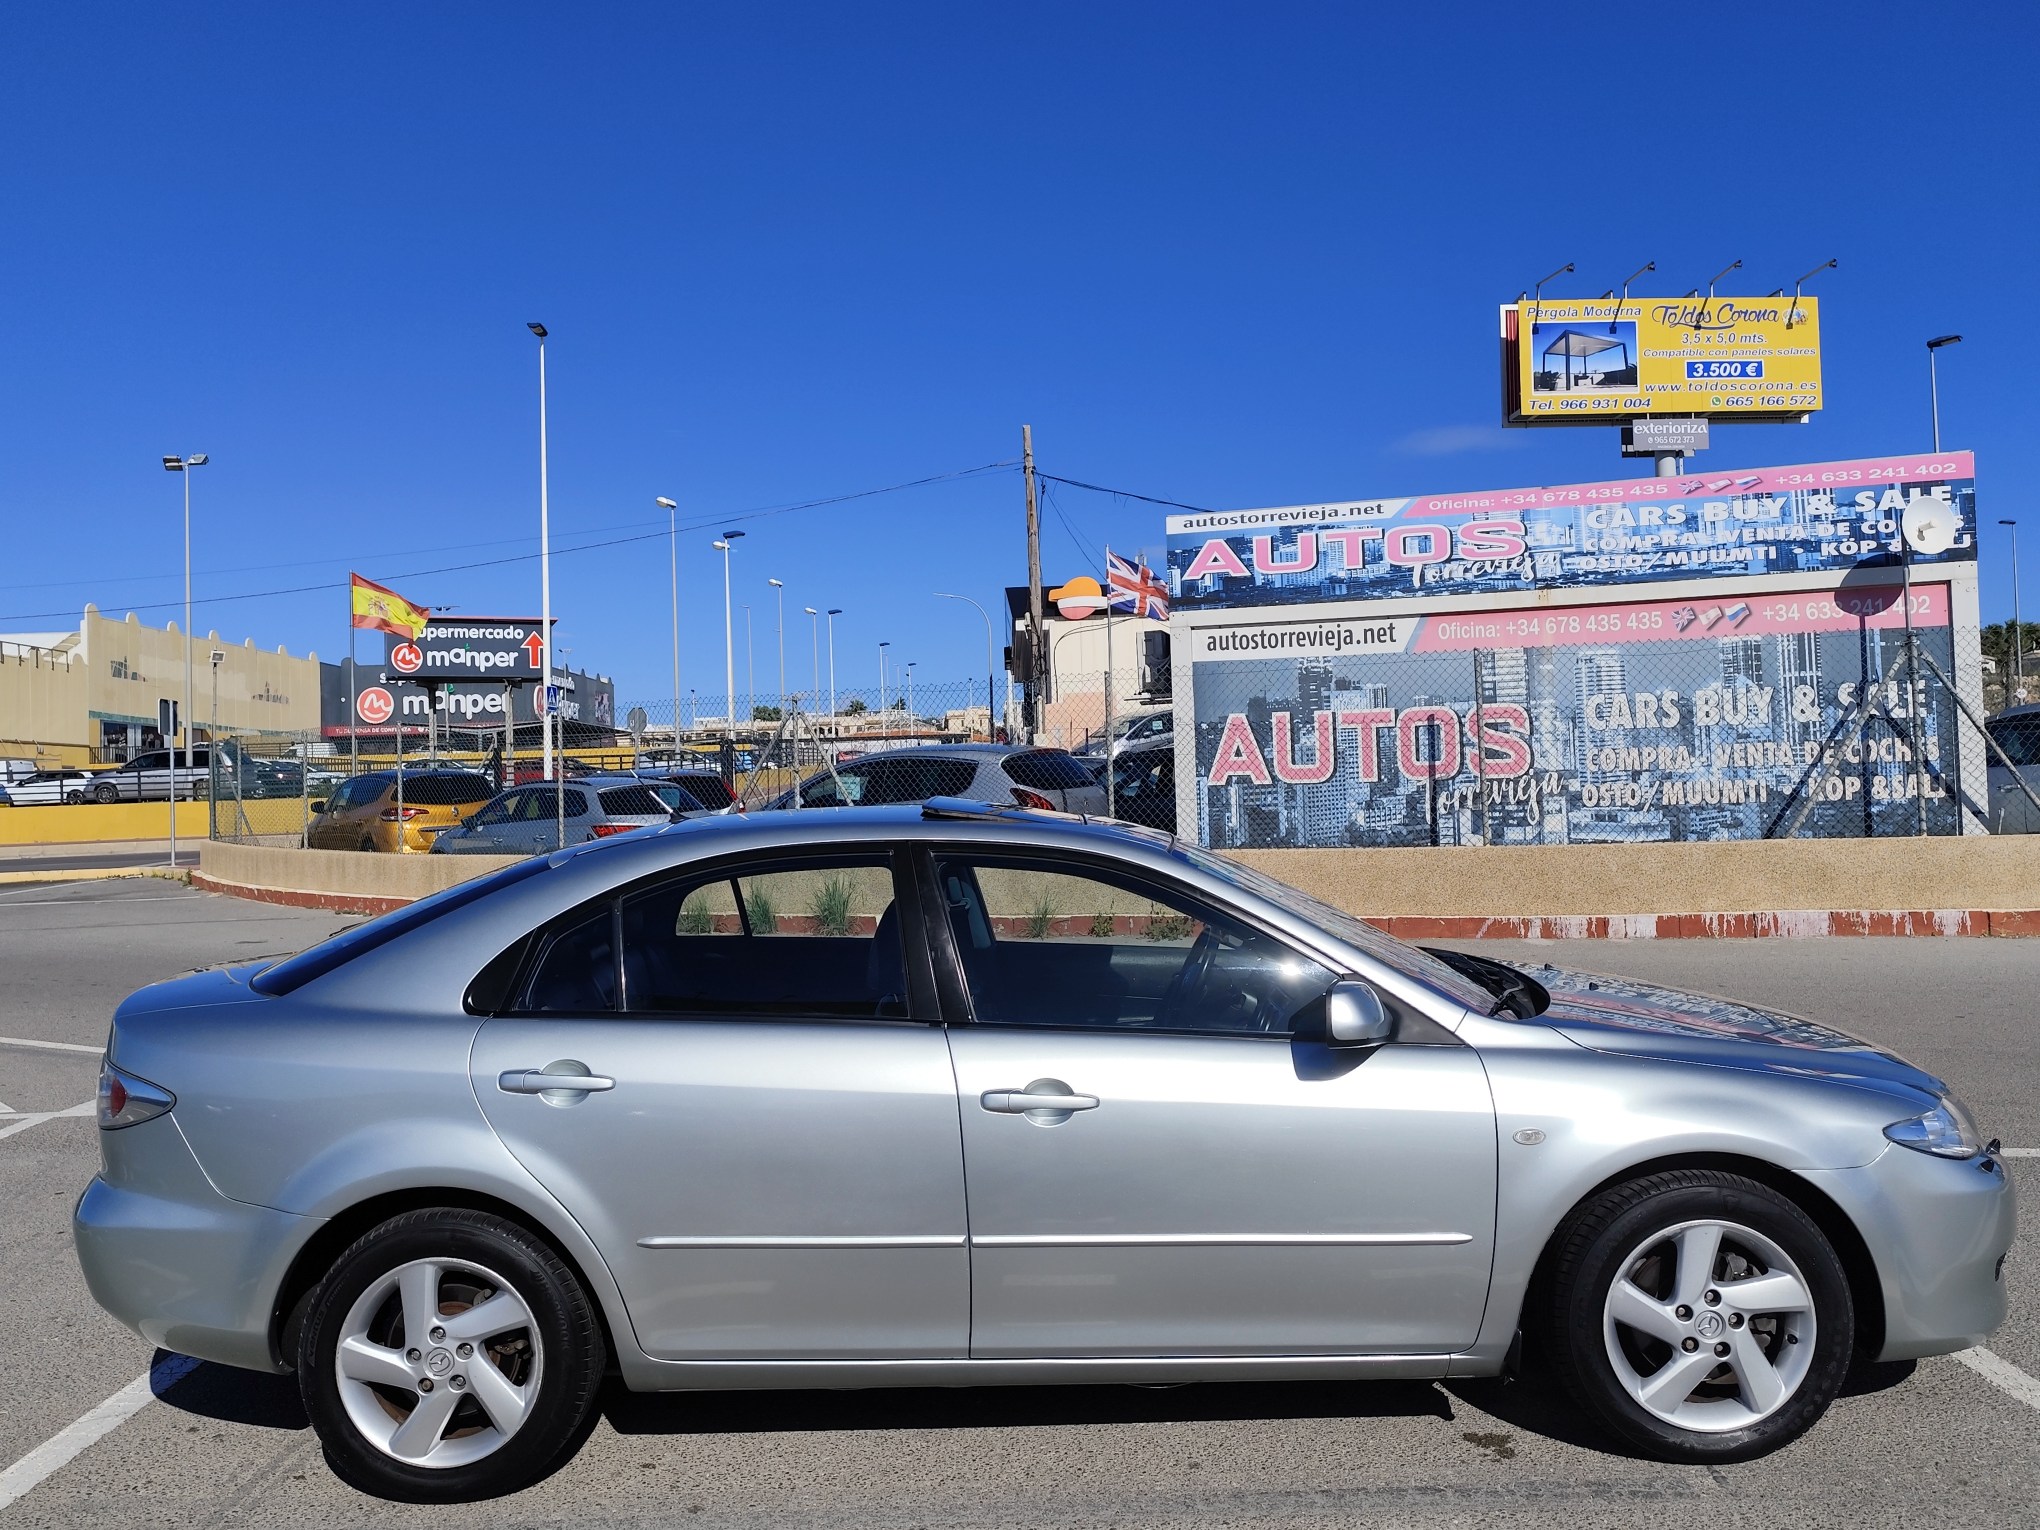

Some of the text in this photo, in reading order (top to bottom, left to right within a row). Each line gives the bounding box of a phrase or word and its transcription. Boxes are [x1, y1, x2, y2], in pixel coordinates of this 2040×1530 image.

[1583, 306, 1641, 317] Moderna
[1651, 302, 1779, 329] Toldos Corona
[1681, 332, 1768, 346] 3,5 x 5,0 mts.
[1643, 348, 1705, 358] Compatible
[1731, 348, 1774, 358] paneles
[1777, 348, 1816, 356] solares
[1692, 362, 1759, 377] 3.500 €
[1645, 381, 1817, 392] www.toldoscorona.es
[1529, 397, 1652, 411] Tel. 966 931 004
[1725, 395, 1817, 407] 665 166 572
[1634, 421, 1708, 435] exterioriza
[1654, 435, 1695, 444] 965 672 373
[1183, 462, 1957, 529] autostorrevieja.net Oficina: +34 678 435 435 +34 633 241 402
[1586, 503, 1688, 530] CARS
[1703, 496, 1788, 523] BUY
[1807, 493, 1838, 515] &
[1722, 524, 1807, 543] VENTA
[1818, 521, 1850, 538] DE
[1181, 519, 1527, 582] AUTOS
[1820, 537, 1878, 557] KÖP
[1410, 552, 1562, 589] Torrevieja
[419, 625, 525, 641] upermercado
[1207, 595, 1931, 651] autostorrevieja.net Oficina: +34 678 435 435 +34 633 241 402
[426, 647, 519, 673] manper
[1585, 690, 1681, 732] CARS
[1694, 686, 1775, 727] BUY
[1791, 684, 1823, 723] &
[1207, 703, 1532, 786] AUTOS
[1586, 745, 1692, 773] COMPRA
[1714, 741, 1795, 768] VENTA
